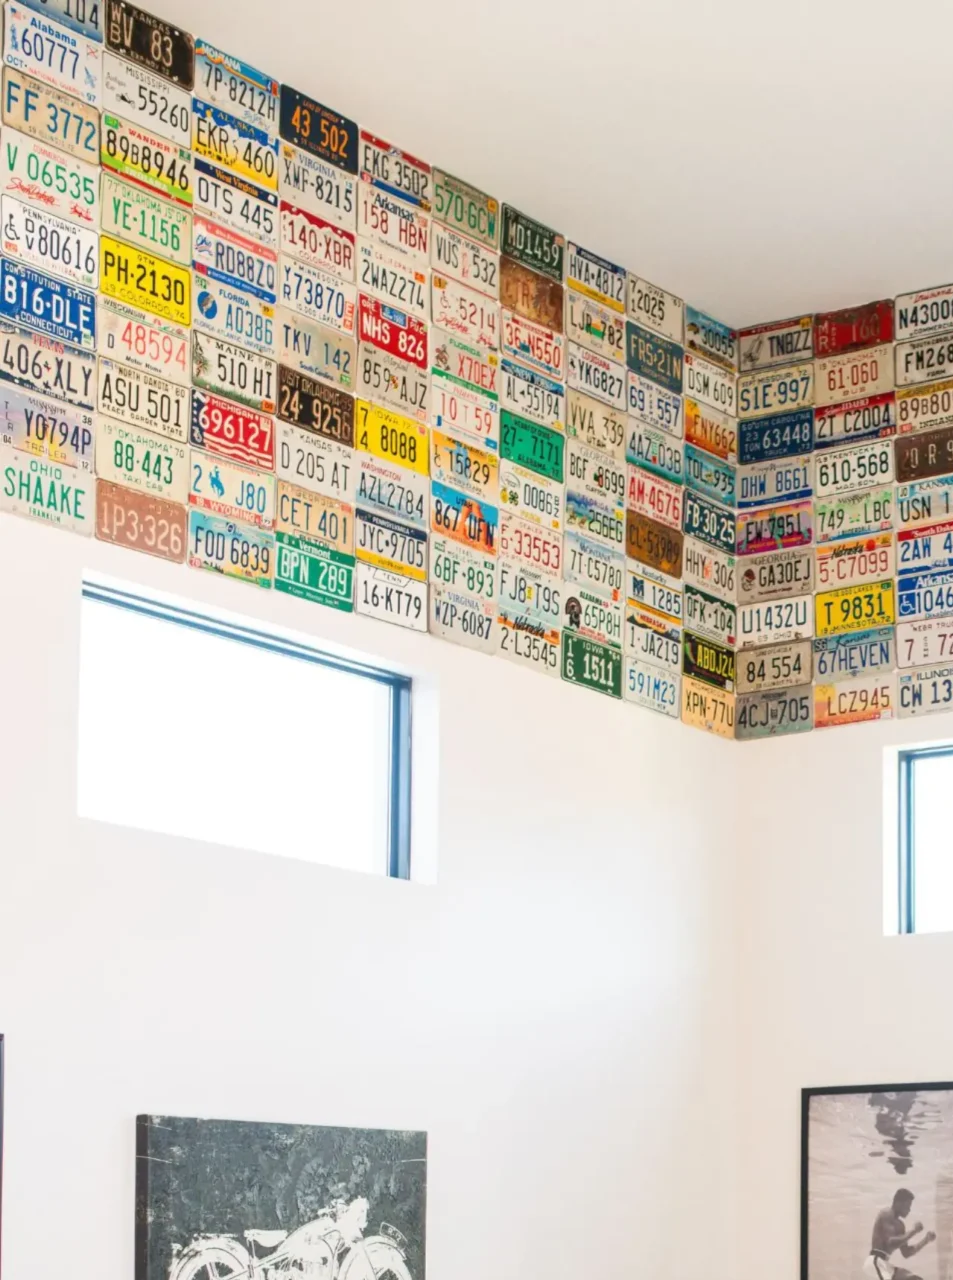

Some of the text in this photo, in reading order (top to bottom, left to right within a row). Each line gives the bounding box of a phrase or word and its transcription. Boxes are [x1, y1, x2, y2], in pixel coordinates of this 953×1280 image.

[30, 17, 76, 46] Alabama
[21, 28, 78, 77] 60777
[125, 66, 169, 93] MISSISSIPPI
[7, 80, 95, 150] FF 3772
[138, 85, 188, 131] 55260
[291, 106, 347, 157] 43 502
[298, 154, 335, 179] VIRGINIA
[364, 145, 429, 199] EKG 3502
[363, 200, 427, 252] 158 HBN
[374, 193, 414, 226] Arkansas
[38, 225, 94, 273] 80616
[4, 262, 90, 304] CONSTITUTION STATE
[219, 288, 249, 306] FLORIDA
[104, 299, 145, 319] WISCONSIN
[20, 311, 74, 341] CONNECTICUT
[363, 313, 423, 359] NHS 826
[121, 322, 185, 368] 48594
[215, 339, 253, 361] MAINE
[283, 324, 350, 373] TKV 142
[3, 339, 91, 395] 406 XLY
[363, 358, 426, 409] 859 AJZ
[102, 373, 180, 427] ASU 501
[211, 396, 253, 419] MICHIGAN
[629, 385, 679, 425] 69 557
[197, 403, 270, 450] 696127
[571, 403, 623, 446] VVA 339
[762, 422, 809, 448] 63448
[380, 425, 416, 462] 8088
[30, 460, 61, 479] OHIO
[741, 467, 807, 498] DHW 8661
[4, 468, 84, 518] SHAAKE
[235, 481, 265, 513] J80
[359, 473, 422, 516] AZL2784
[900, 496, 930, 521] USN
[818, 499, 890, 531] 749 LBC
[901, 537, 930, 561] 2AW
[279, 549, 346, 594] BPN 289
[652, 586, 680, 614] 1285
[824, 593, 884, 624] T 9831
[742, 602, 806, 633] U1432U
[583, 653, 613, 686] 1511
[746, 653, 801, 682] 84 554
[818, 642, 888, 673] 67HEVEN
[827, 686, 889, 716] LCZ945
[900, 684, 921, 707] CW
